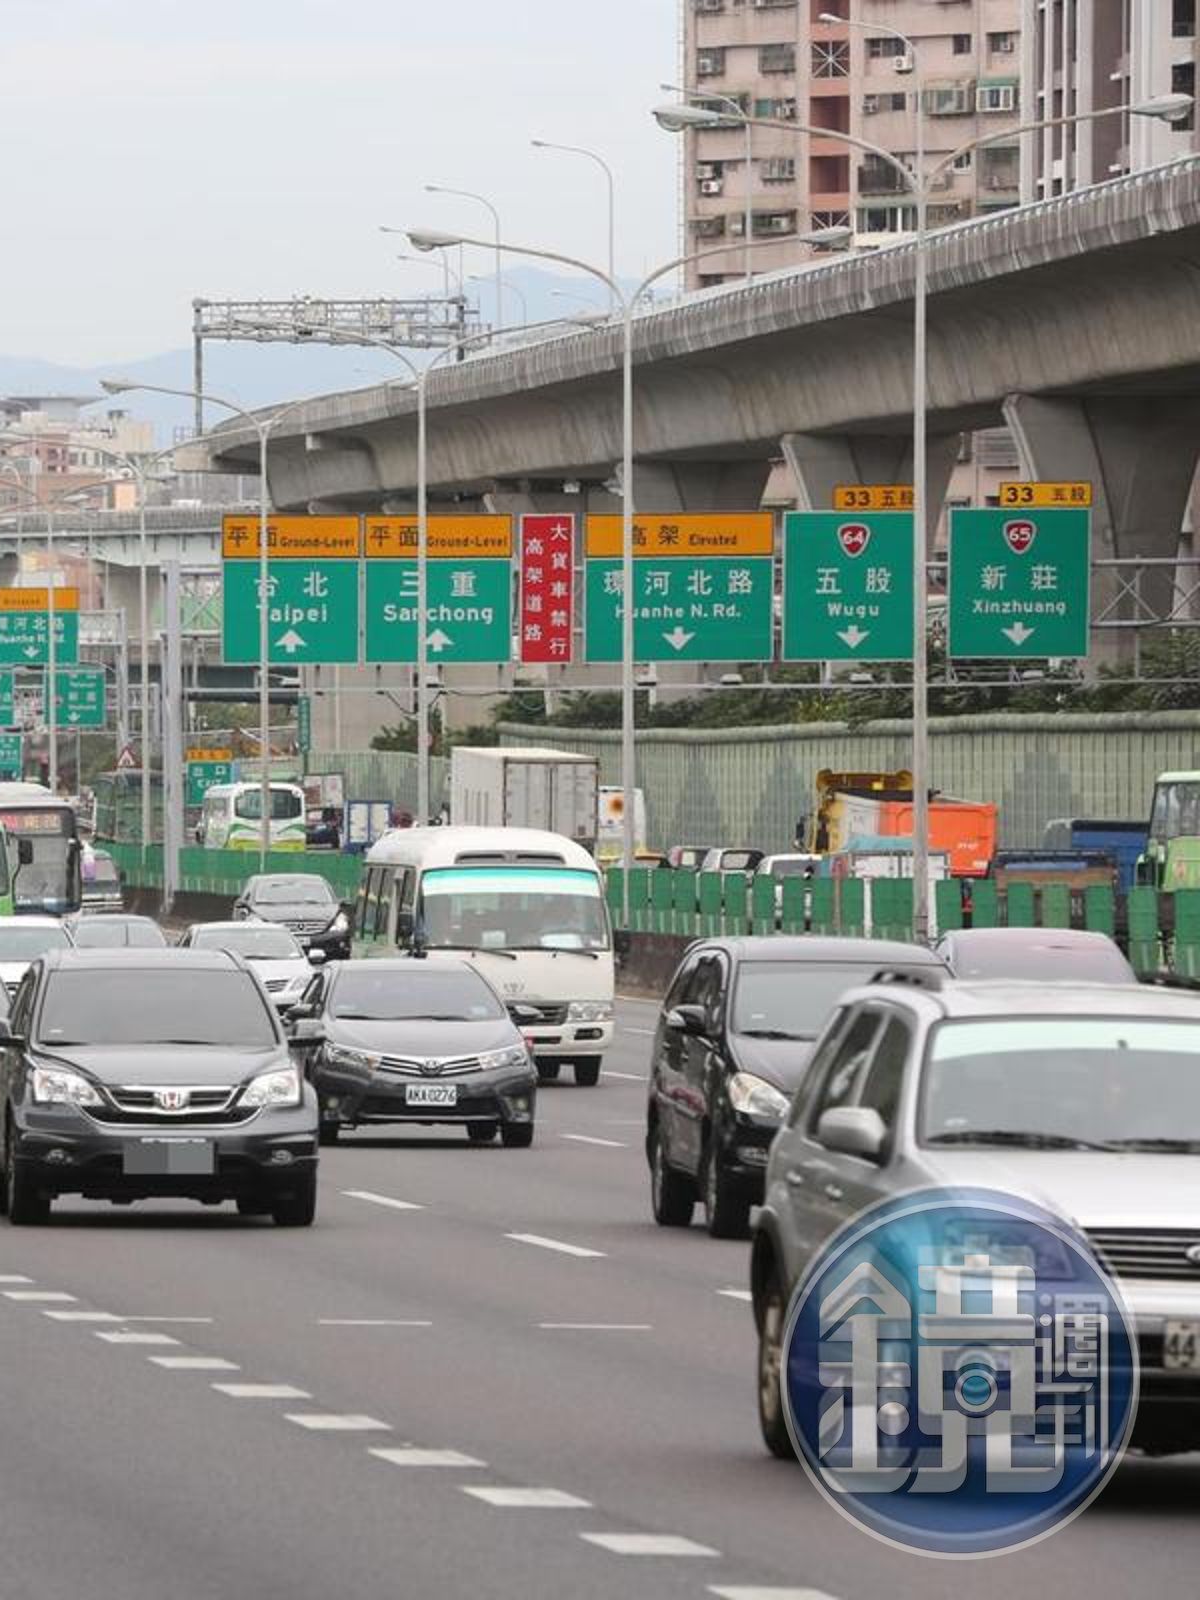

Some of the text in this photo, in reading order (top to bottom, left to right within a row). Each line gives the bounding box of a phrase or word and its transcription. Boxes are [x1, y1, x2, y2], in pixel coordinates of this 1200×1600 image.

[844, 490, 871, 507] 33
[1007, 487, 1034, 502] 33
[843, 530, 865, 545] 64
[1009, 527, 1032, 542] 65
[399, 570, 478, 598] 三重
[816, 566, 892, 594] 五股
[980, 564, 1058, 591] 新莊
[525, 536, 544, 642] 高架道路
[550, 522, 569, 656] 大貨車禁行
[714, 604, 742, 618] Rd.
[828, 602, 880, 619] Wugu
[972, 599, 1067, 616] Xinzhuang
